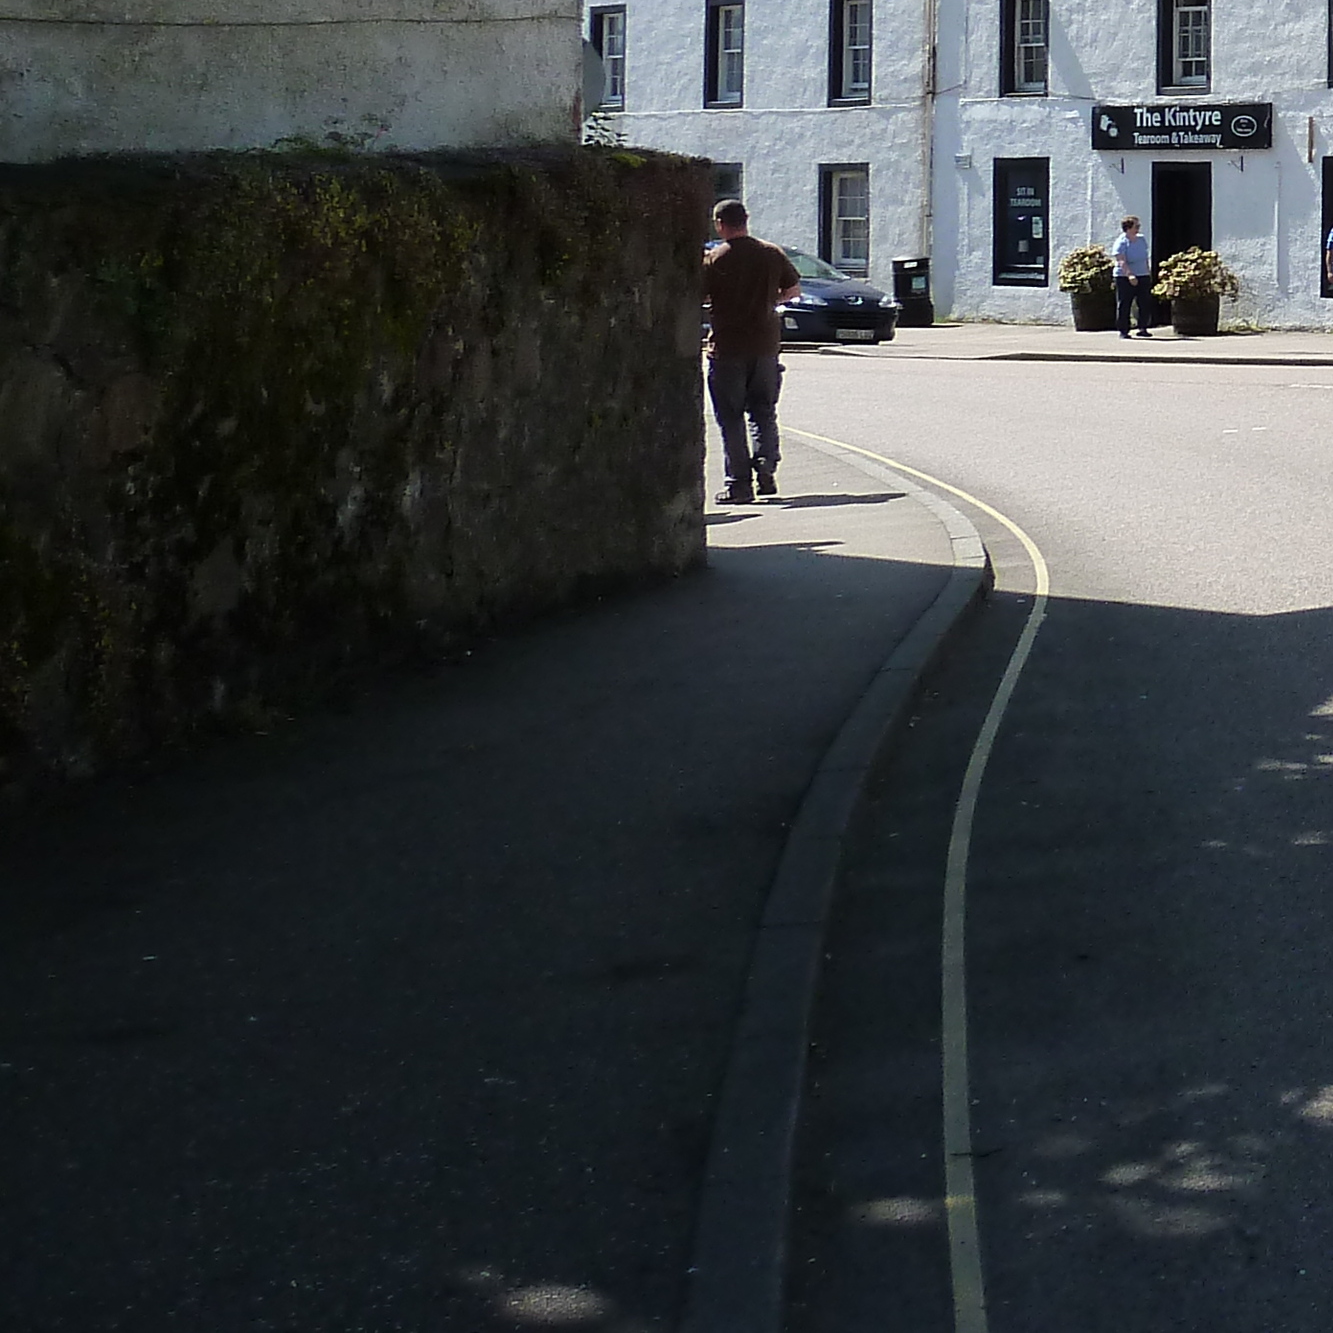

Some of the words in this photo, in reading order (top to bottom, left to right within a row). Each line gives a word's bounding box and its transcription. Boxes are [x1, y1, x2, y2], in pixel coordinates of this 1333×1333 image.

[1133, 107, 1162, 127] The
[1164, 106, 1222, 131] Kintyre
[1132, 132, 1170, 145] Tearoom
[1171, 132, 1178, 145] &
[1178, 131, 1222, 147] Takeaway
